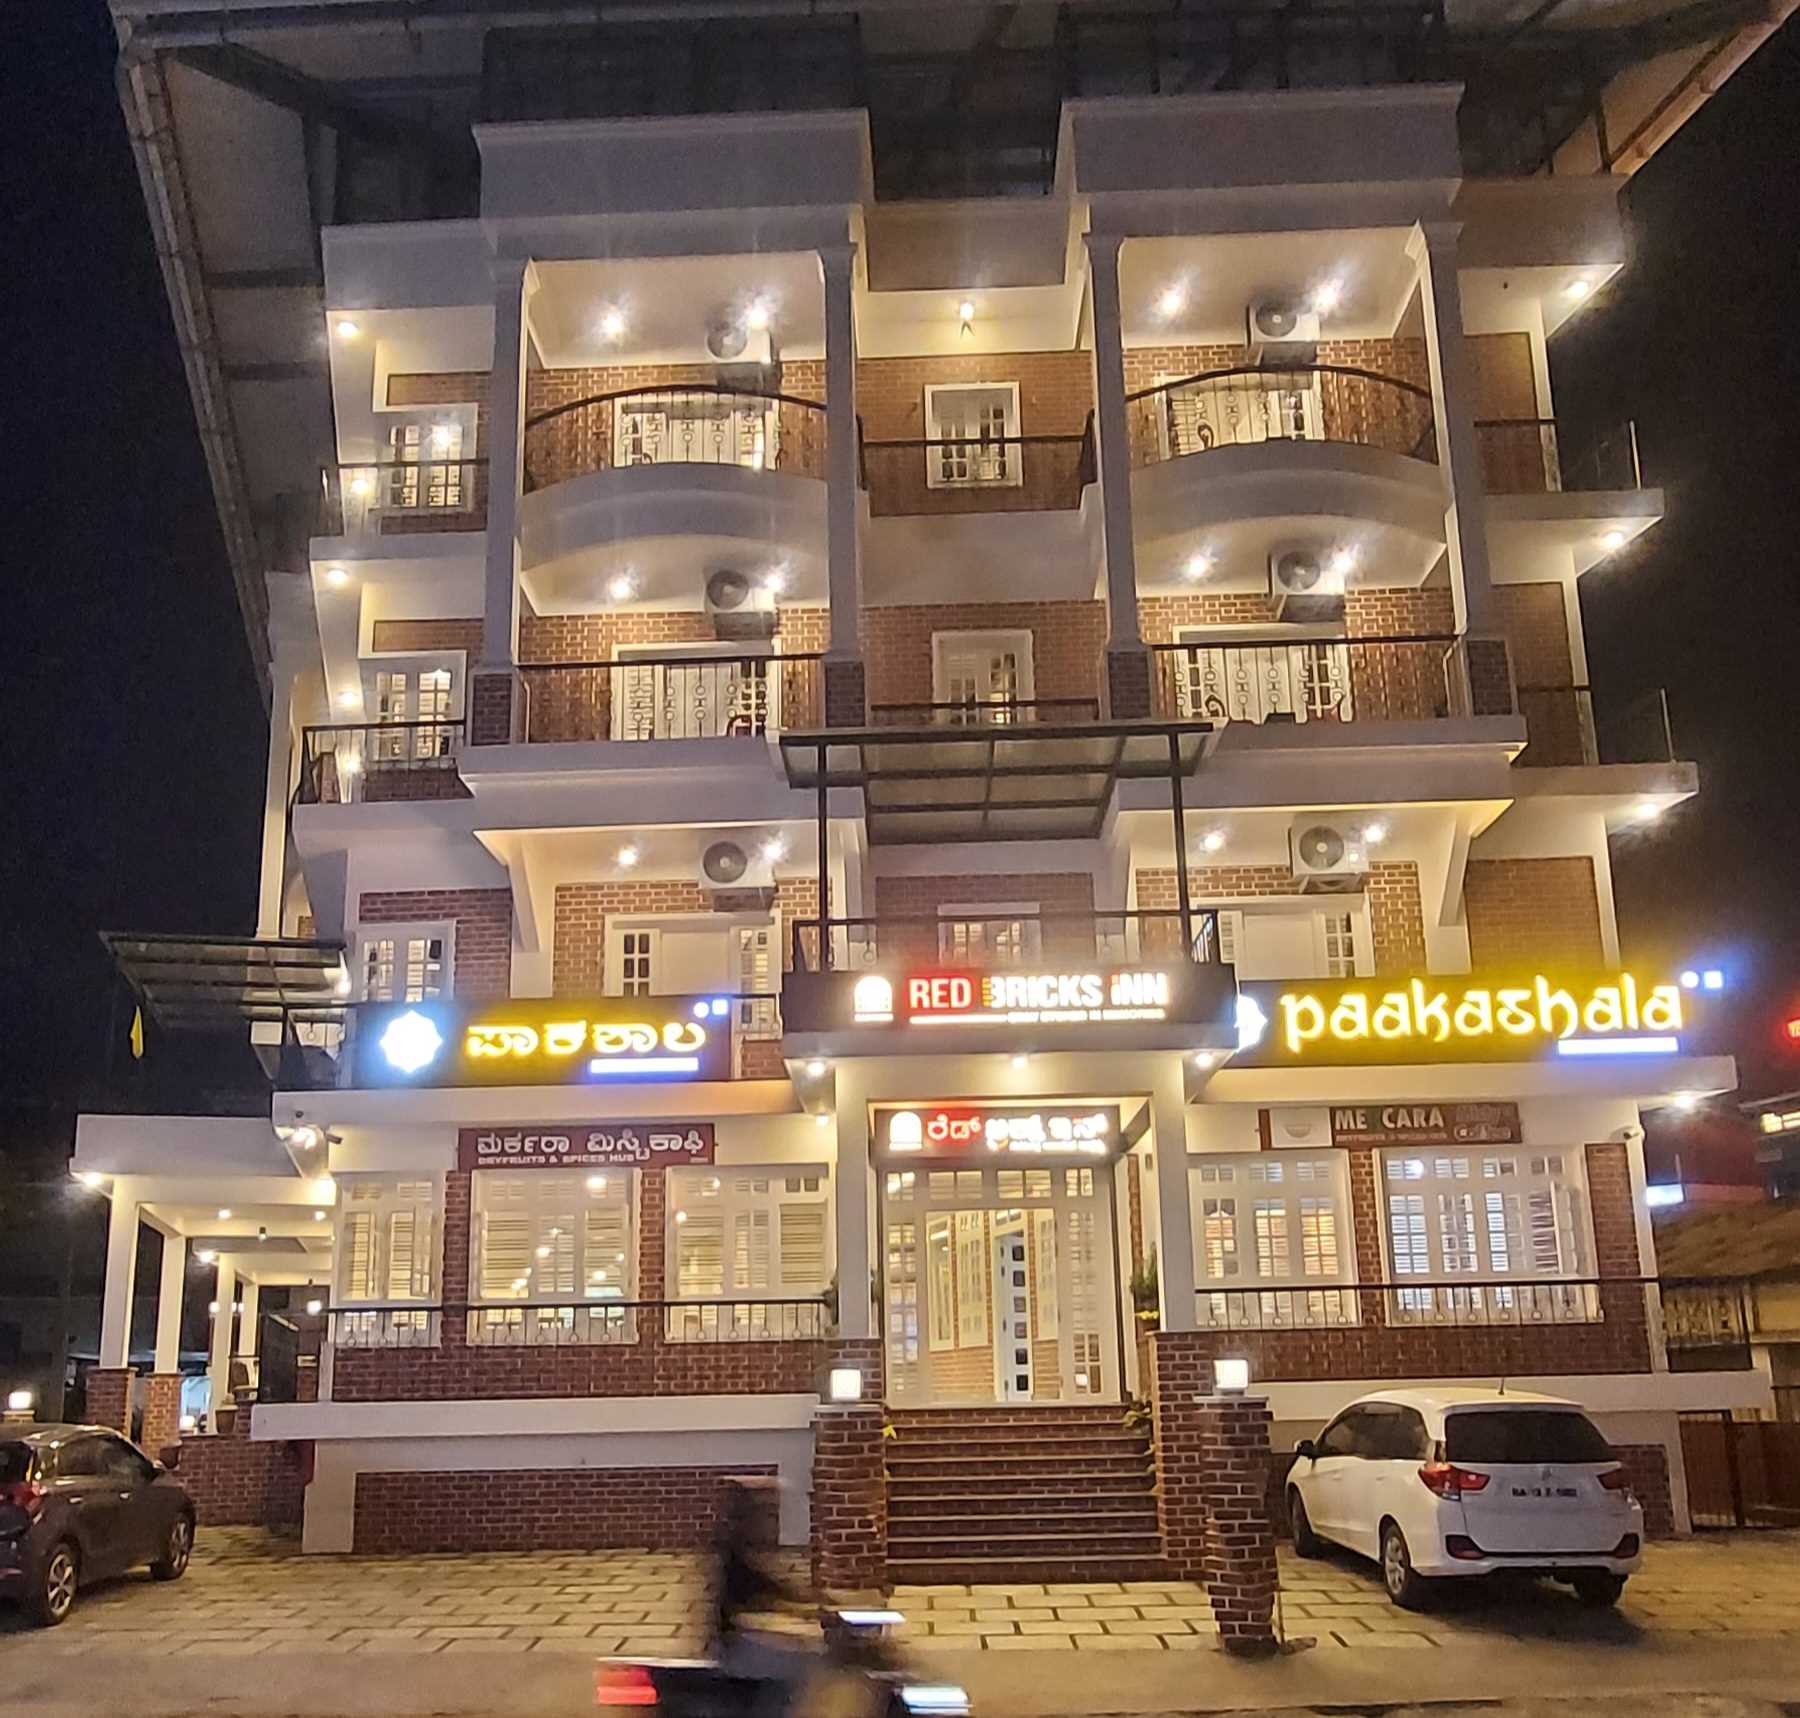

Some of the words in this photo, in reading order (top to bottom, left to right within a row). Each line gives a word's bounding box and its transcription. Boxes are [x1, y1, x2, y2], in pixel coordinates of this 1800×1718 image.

[909, 978, 972, 1008] RED
[982, 975, 1104, 1008] BRICKS
[1280, 973, 1683, 1053] paakashala
[467, 1020, 706, 1057] ಪಾಕಶಾಲ
[549, 1155, 558, 1163] &
